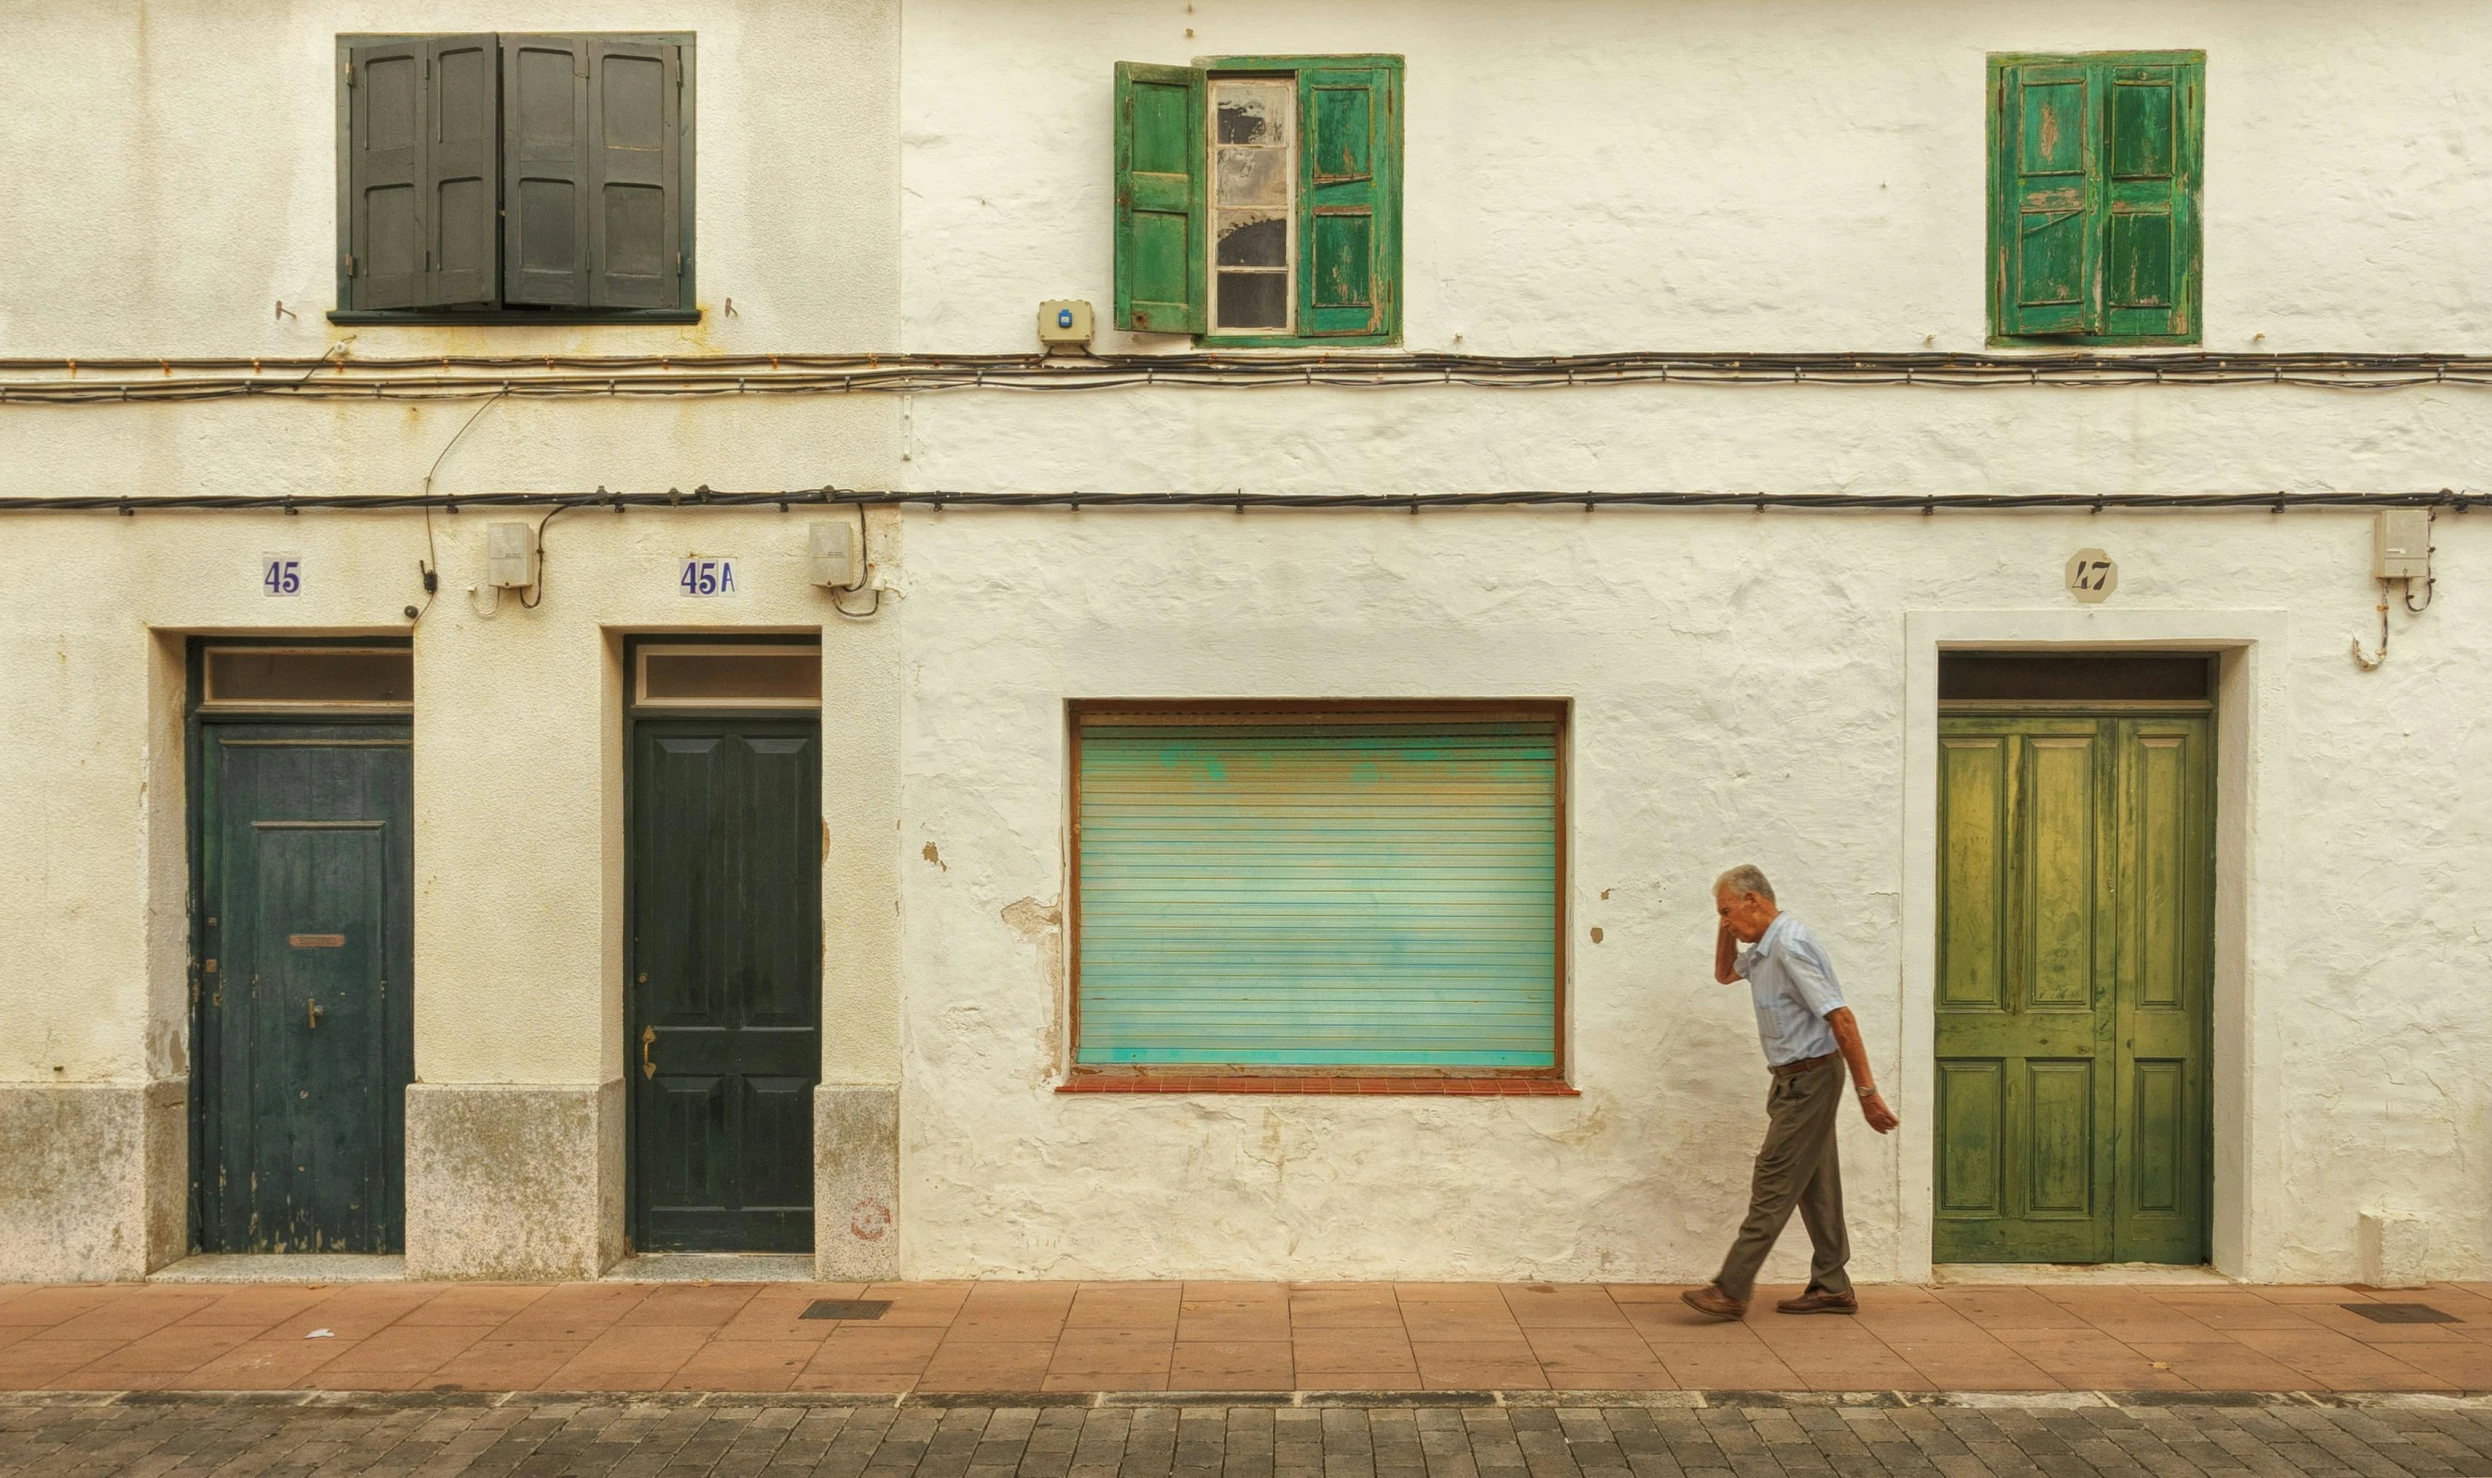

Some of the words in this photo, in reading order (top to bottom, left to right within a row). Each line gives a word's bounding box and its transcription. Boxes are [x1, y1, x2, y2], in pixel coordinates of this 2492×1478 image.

[264, 561, 300, 594] 45
[680, 561, 736, 595] 45A
[2071, 560, 2112, 591] 47
